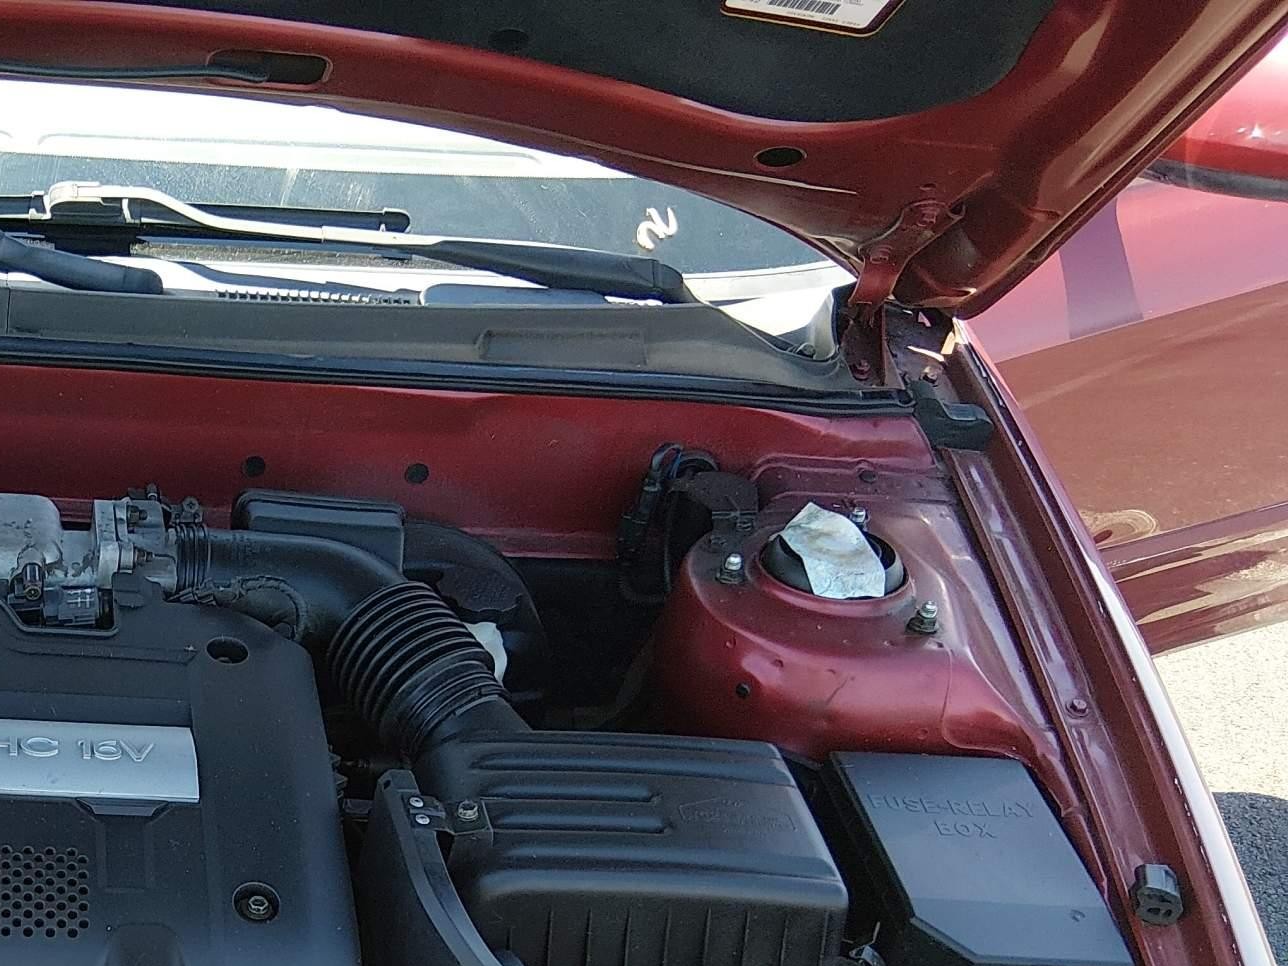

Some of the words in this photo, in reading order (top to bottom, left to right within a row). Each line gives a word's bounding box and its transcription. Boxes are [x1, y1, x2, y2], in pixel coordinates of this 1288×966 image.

[77, 738, 155, 762] 16V
[866, 793, 1034, 818] FUSE-RELAY
[934, 820, 999, 839] BOX
